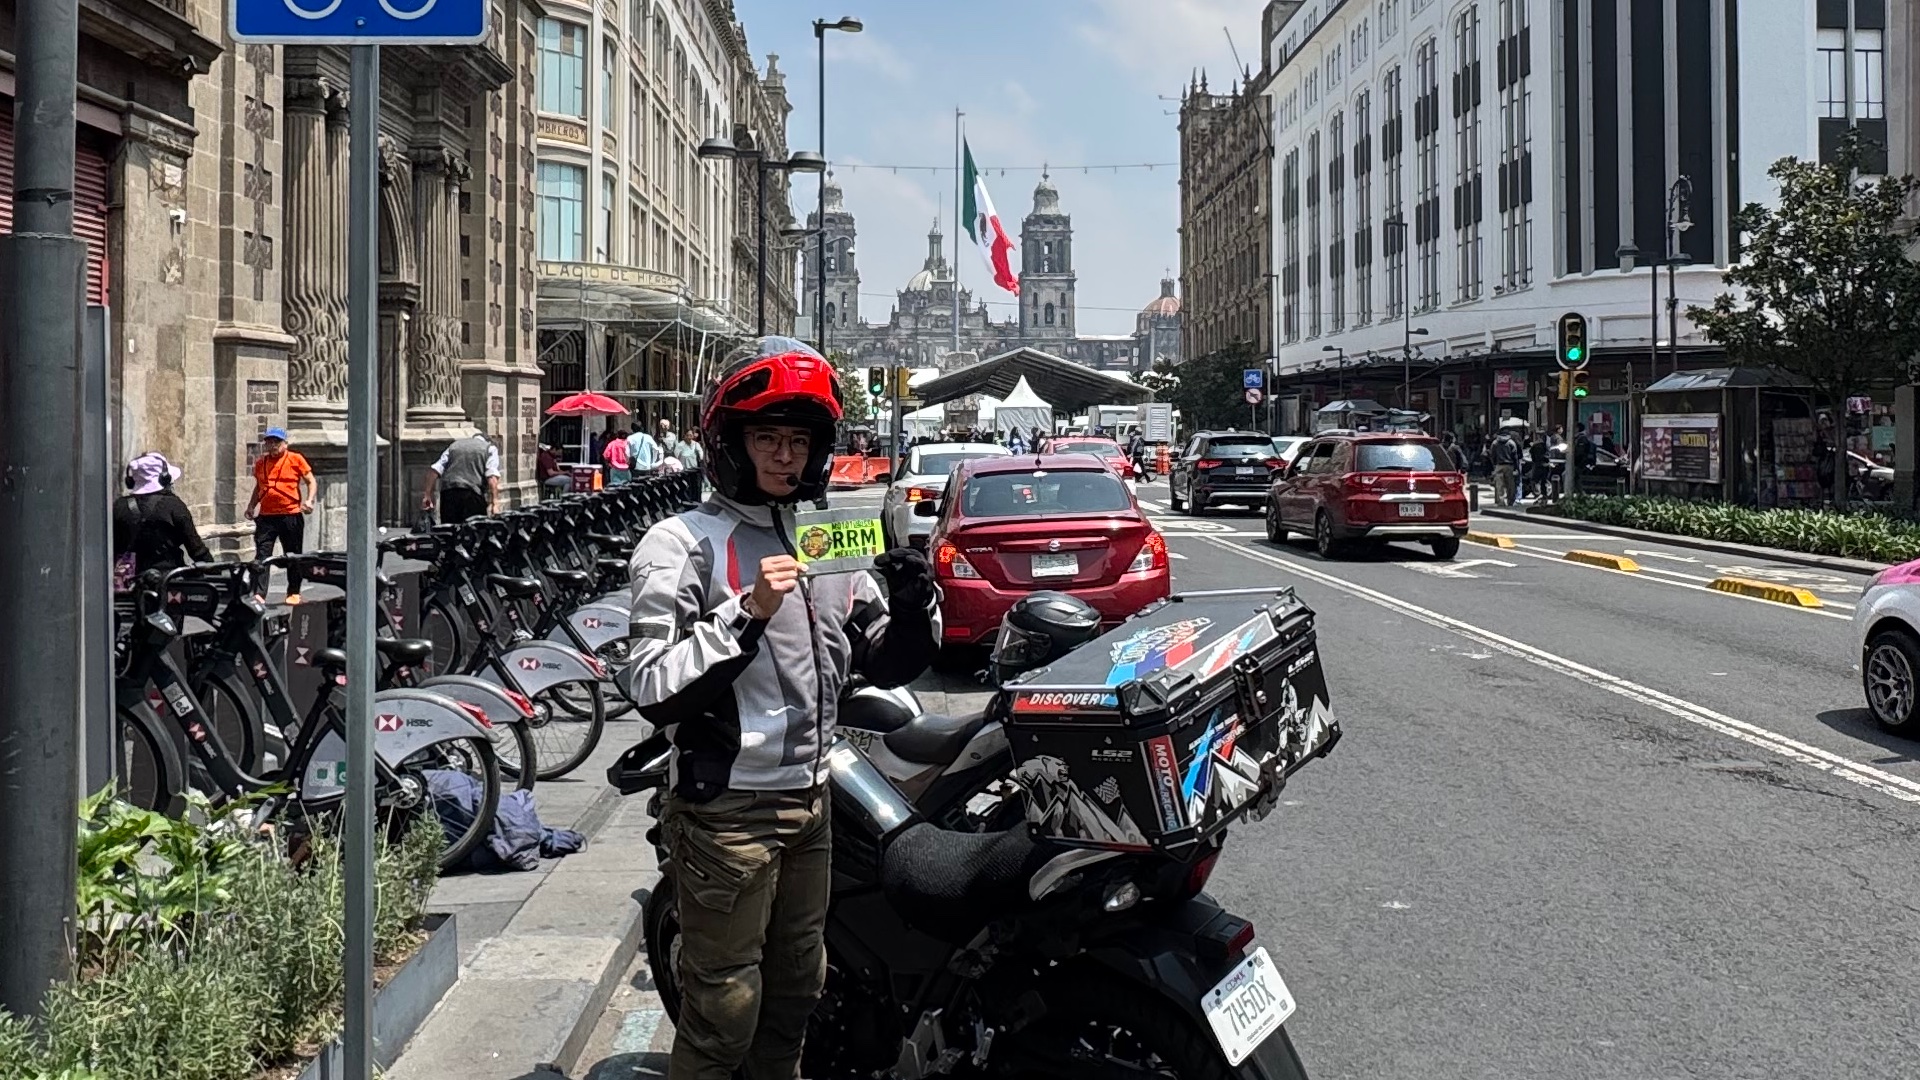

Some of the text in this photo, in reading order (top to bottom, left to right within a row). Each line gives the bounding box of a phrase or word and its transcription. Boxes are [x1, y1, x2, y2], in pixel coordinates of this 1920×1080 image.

[610, 268, 629, 281] DE
[832, 528, 877, 549] RRM
[542, 662, 562, 671] HSBC
[1029, 693, 1109, 705] DISCOVERY
[406, 718, 433, 728] HSBC
[1091, 749, 1133, 757] LS2
[1154, 744, 1174, 787] MOTO
[1161, 791, 1180, 831] RACING
